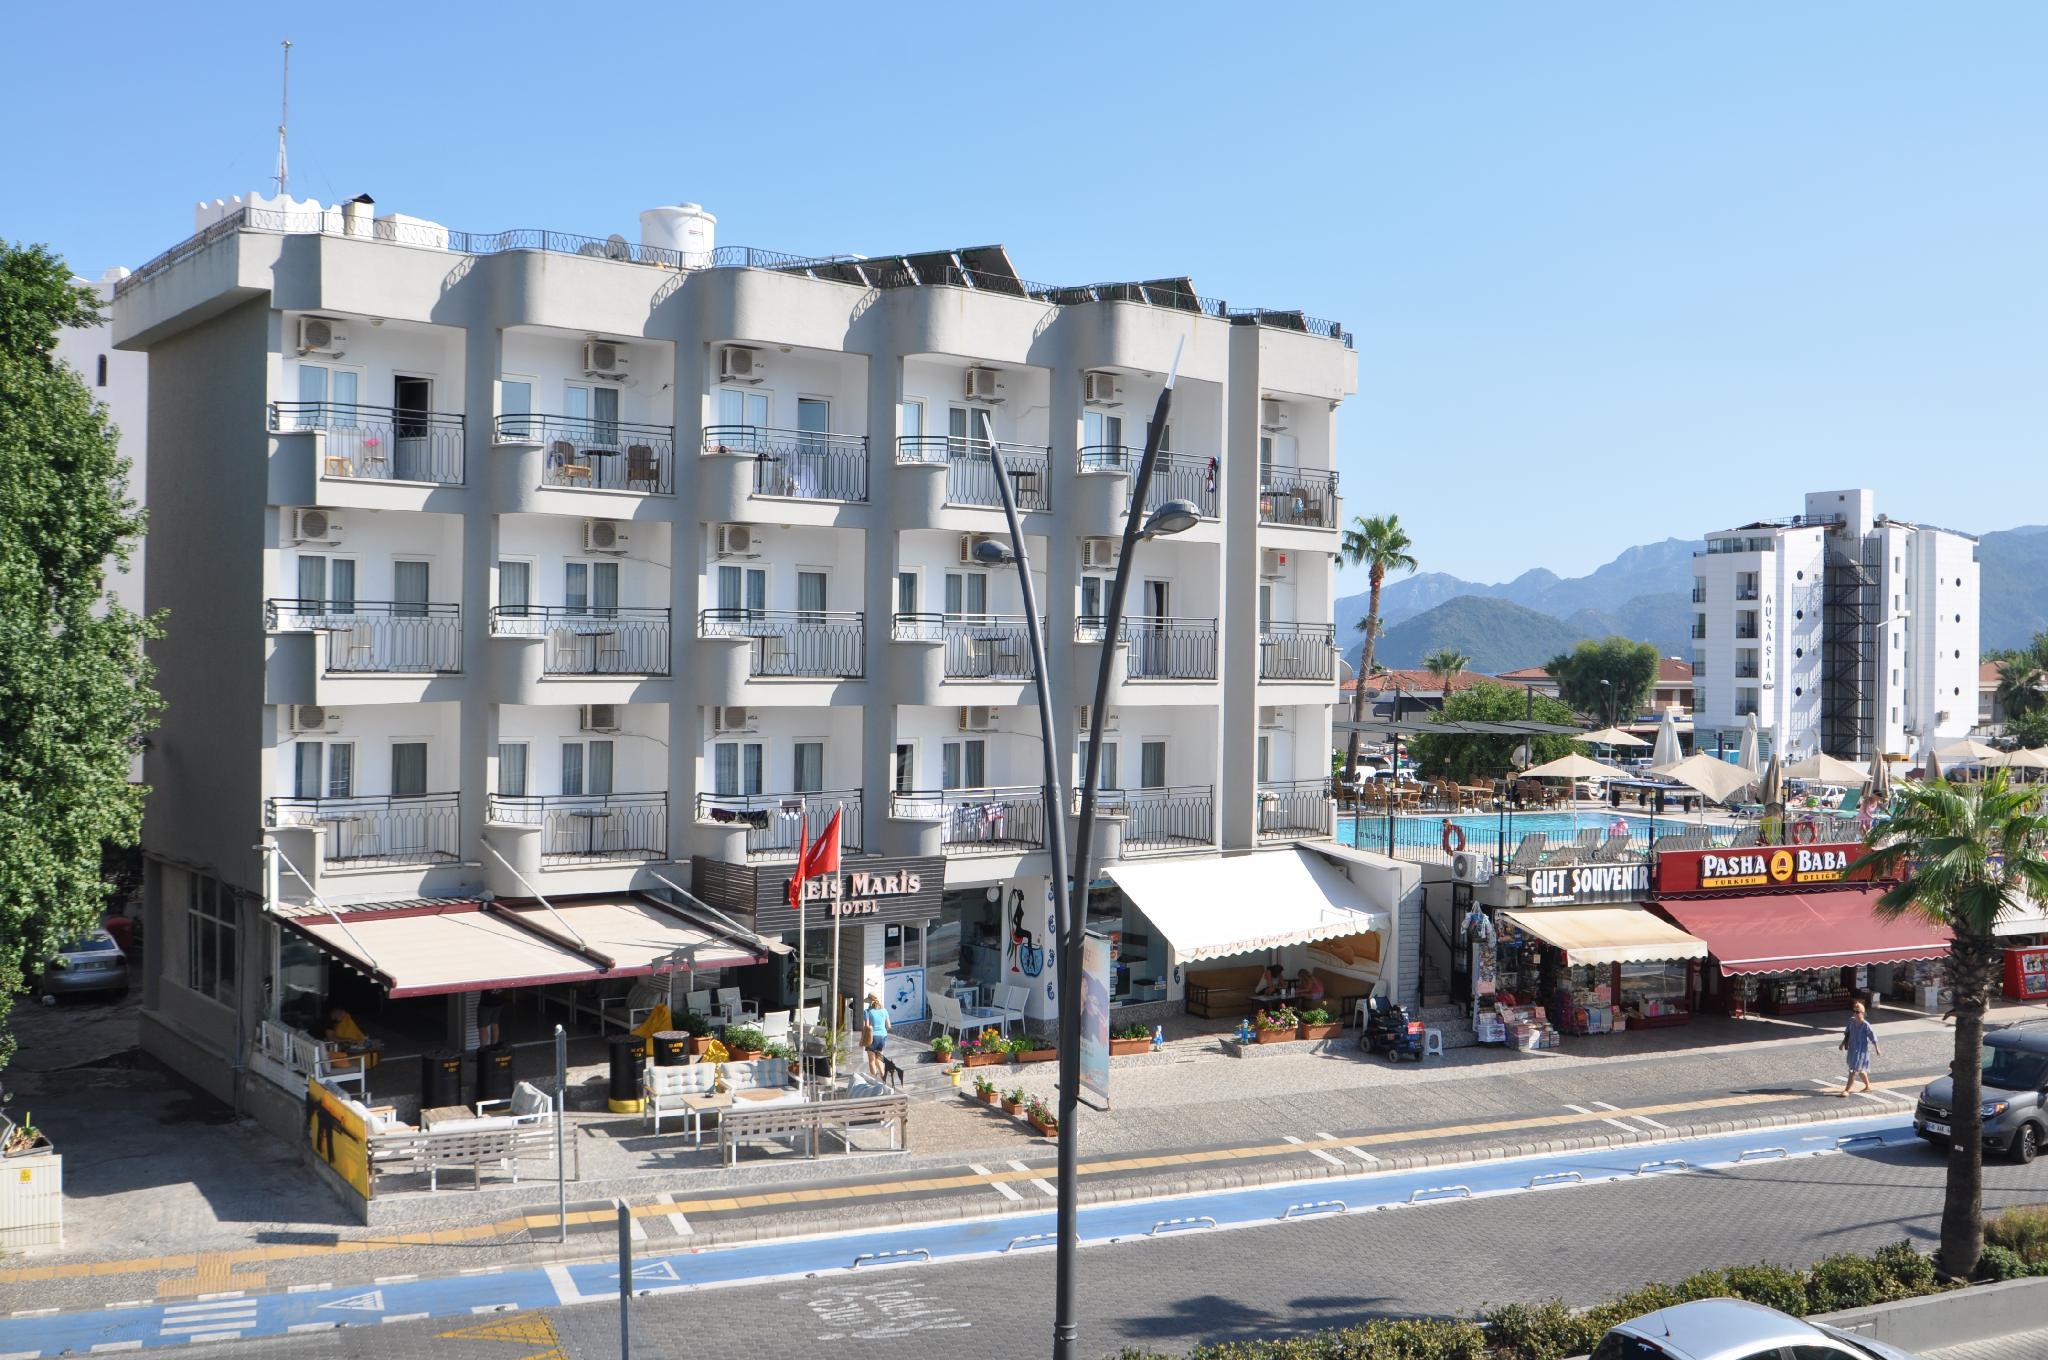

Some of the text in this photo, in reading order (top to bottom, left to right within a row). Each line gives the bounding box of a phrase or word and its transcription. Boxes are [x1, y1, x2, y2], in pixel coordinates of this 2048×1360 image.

[1702, 849, 1847, 877] PASHA BABA
[1531, 866, 1649, 895] GIFT SOUVENIR
[1715, 878, 1756, 886] TURKISH
